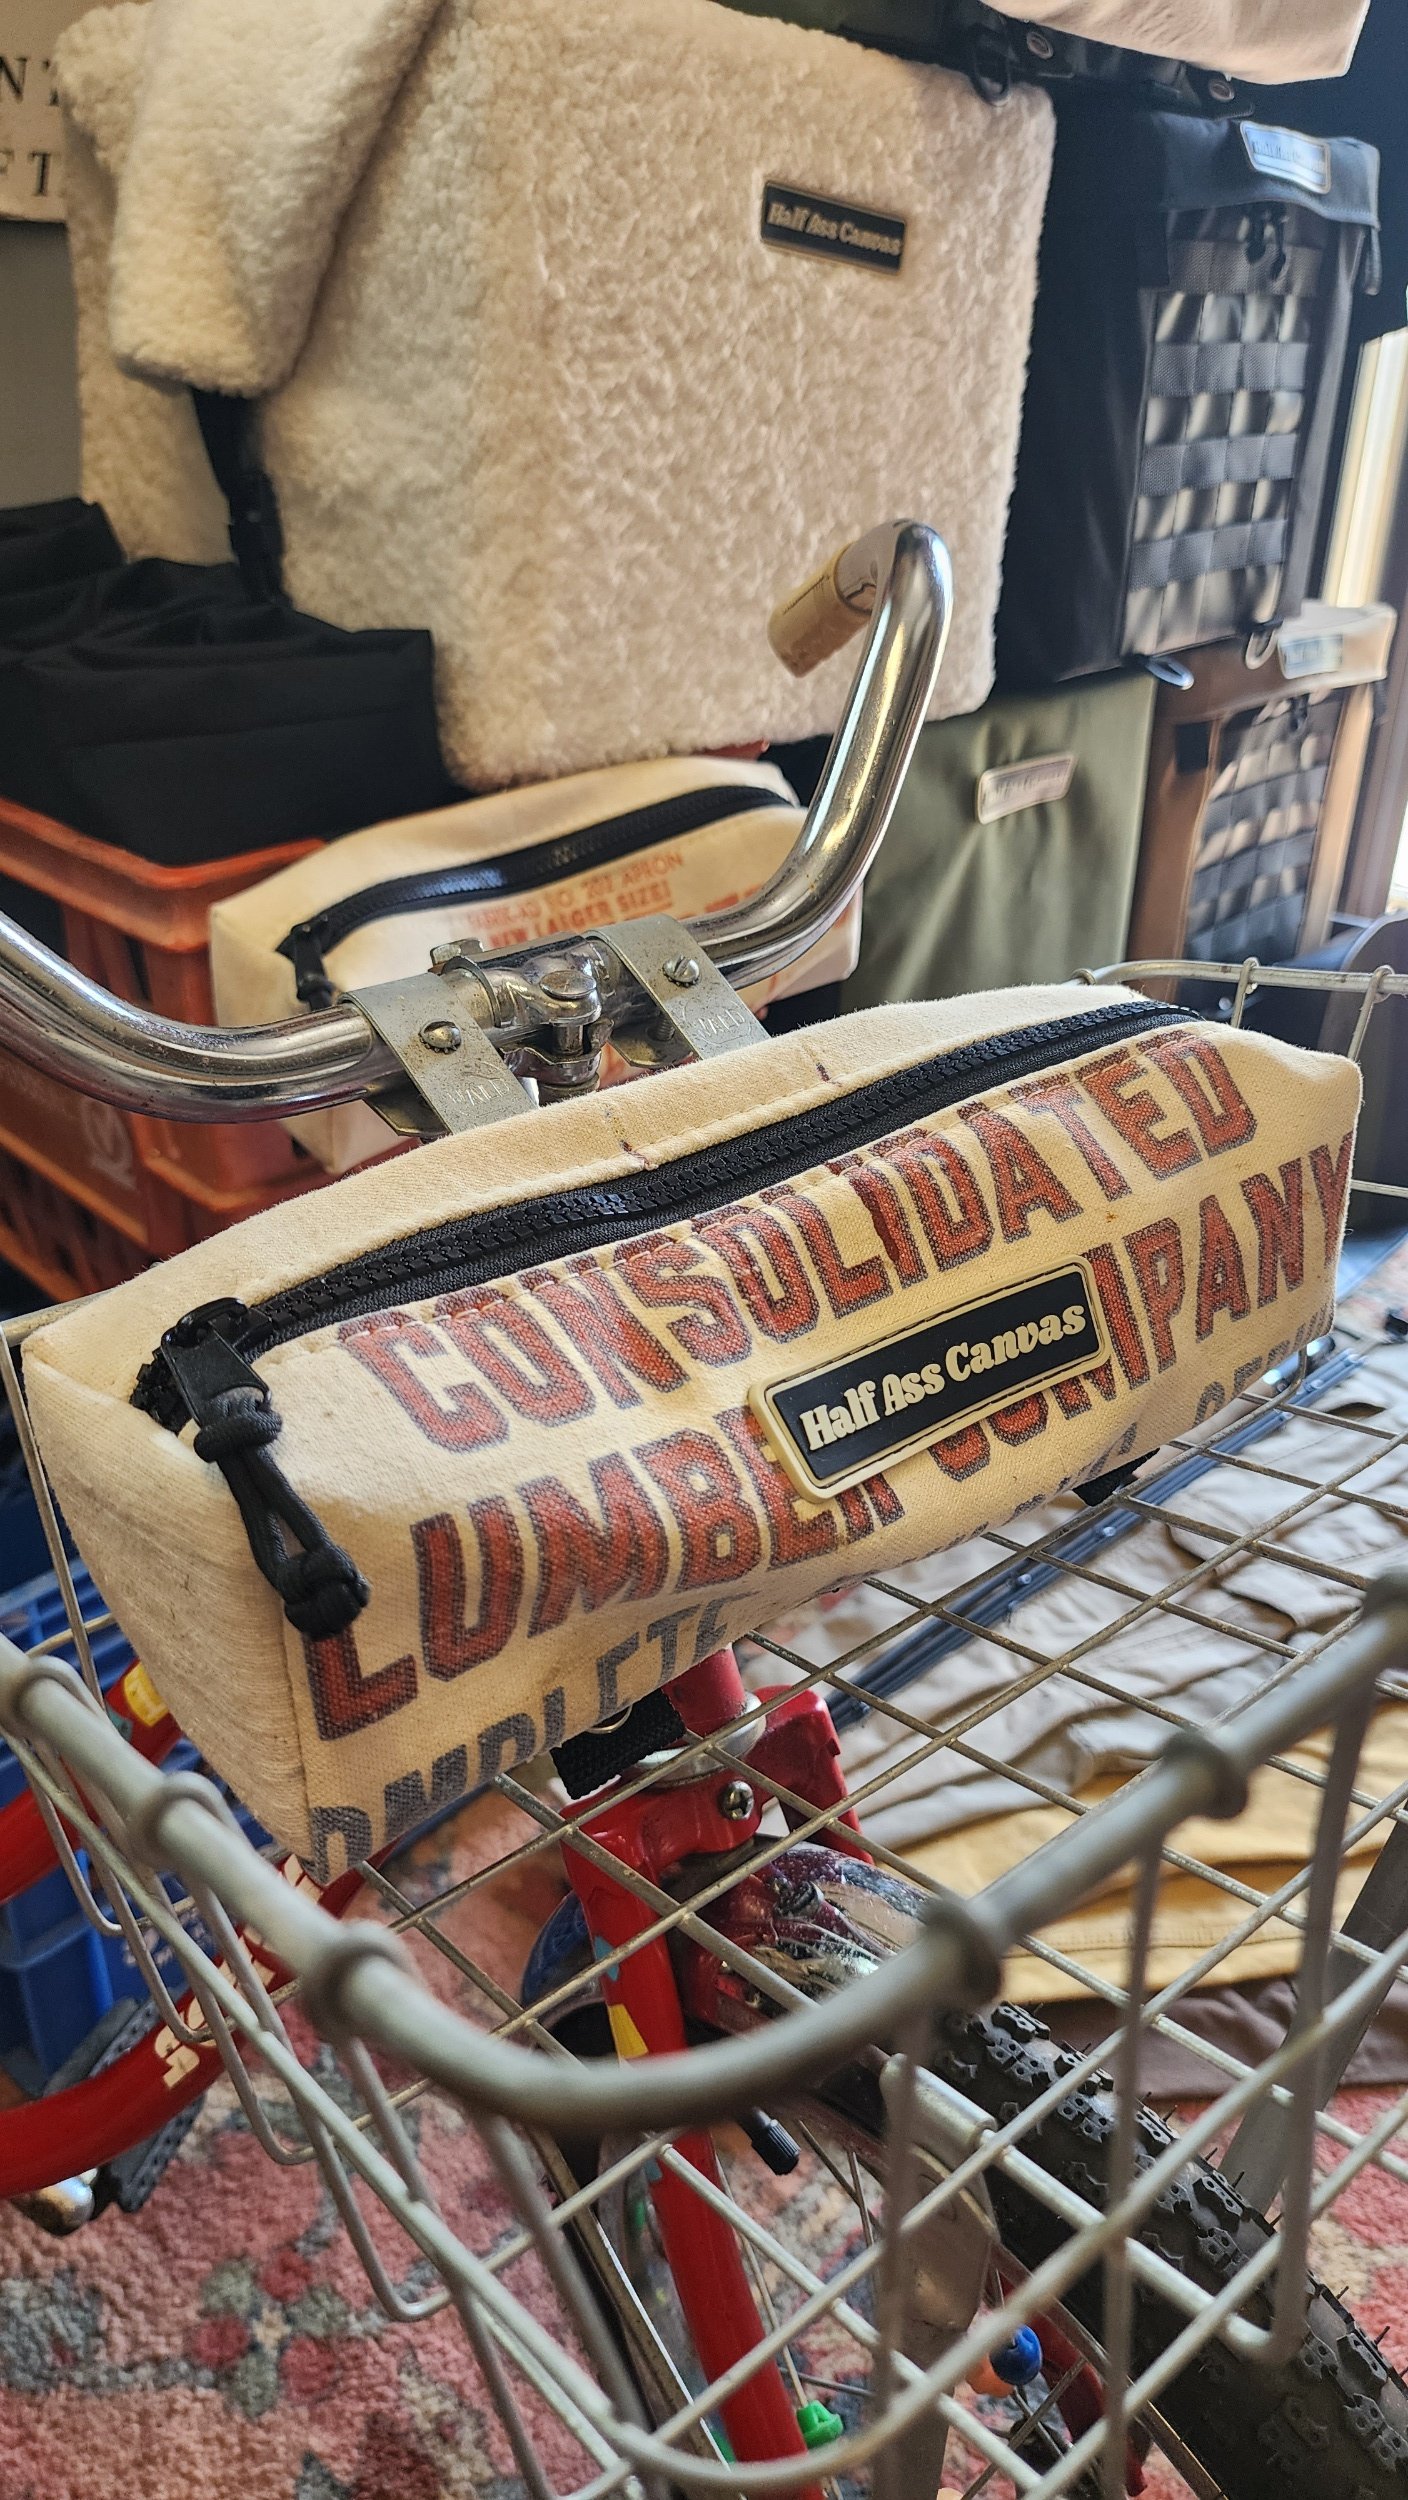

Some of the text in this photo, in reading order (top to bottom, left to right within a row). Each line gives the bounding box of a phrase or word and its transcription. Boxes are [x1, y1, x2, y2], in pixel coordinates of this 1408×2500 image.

[767, 202, 902, 256] Half Ass Canvas
[336, 1030, 1258, 1455] CONSOLIDATED
[799, 1305, 1087, 1451] Half Ass Canvas
[303, 1404, 905, 1742] LUMBE
